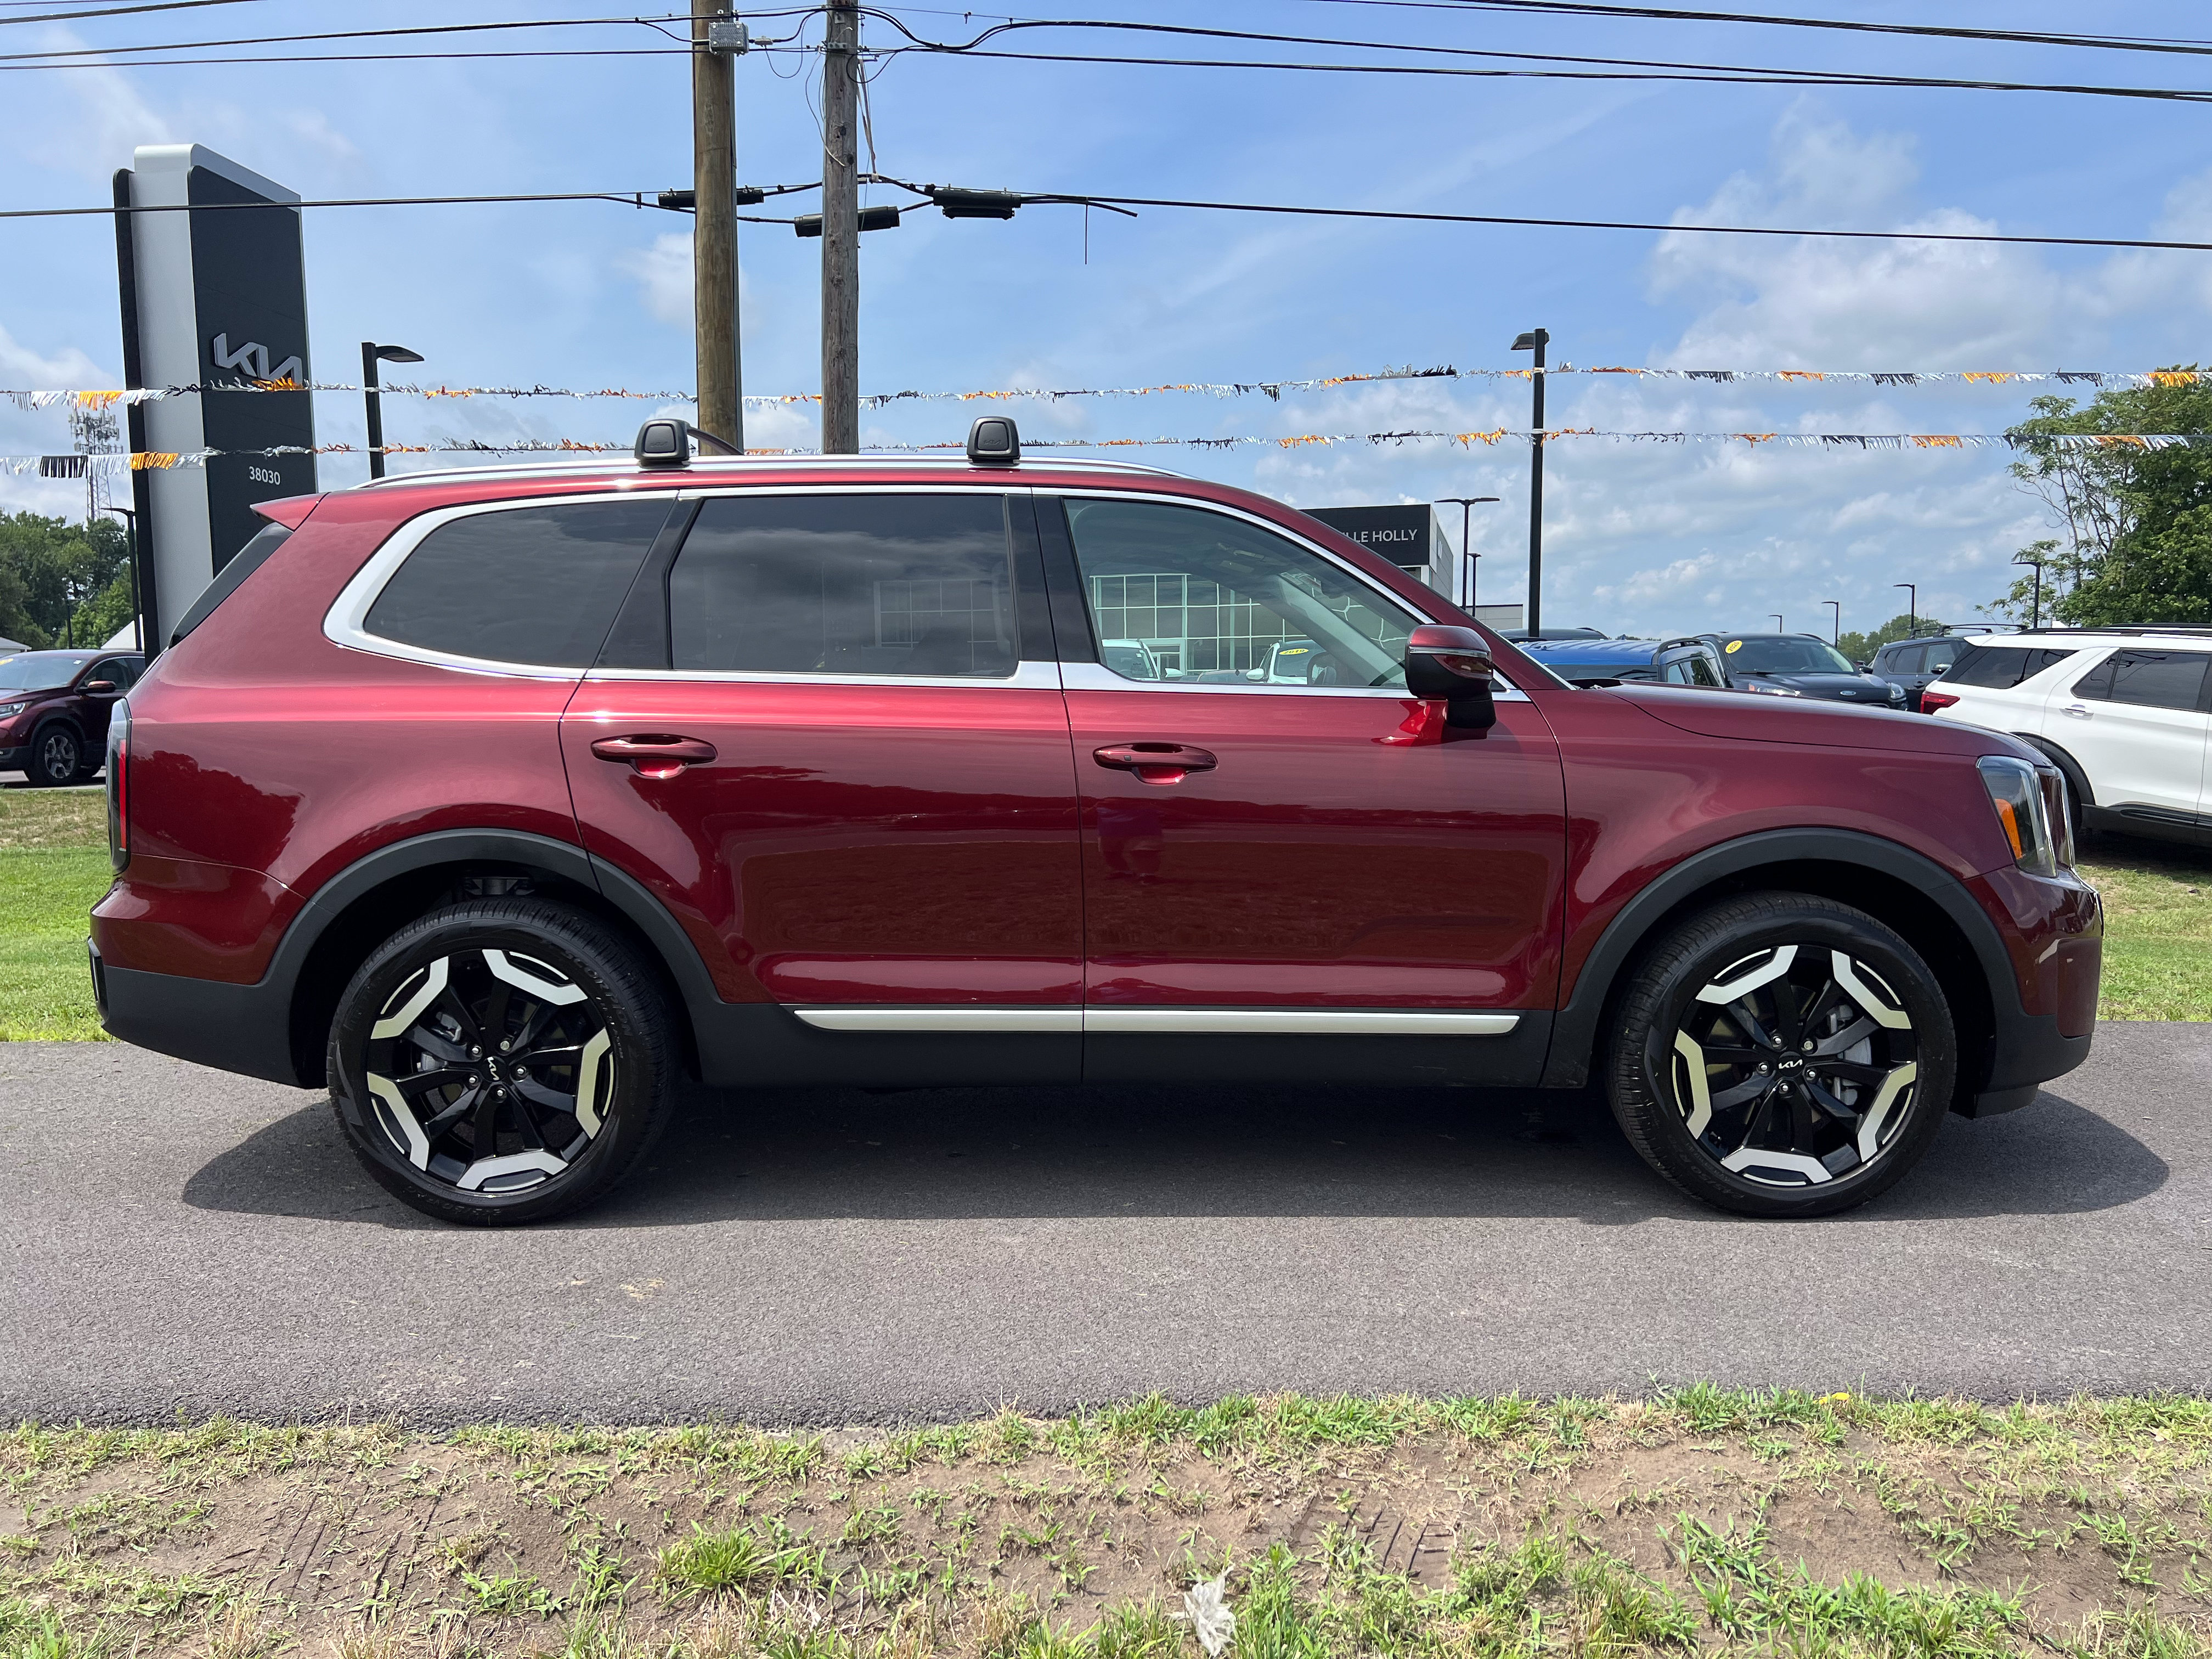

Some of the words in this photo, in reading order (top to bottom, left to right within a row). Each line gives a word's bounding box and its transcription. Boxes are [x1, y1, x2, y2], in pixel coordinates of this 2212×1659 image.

[249, 466, 281, 486] 38030
[1372, 529, 1418, 542] HOLLY
[1778, 1059, 1803, 1069] KIA
